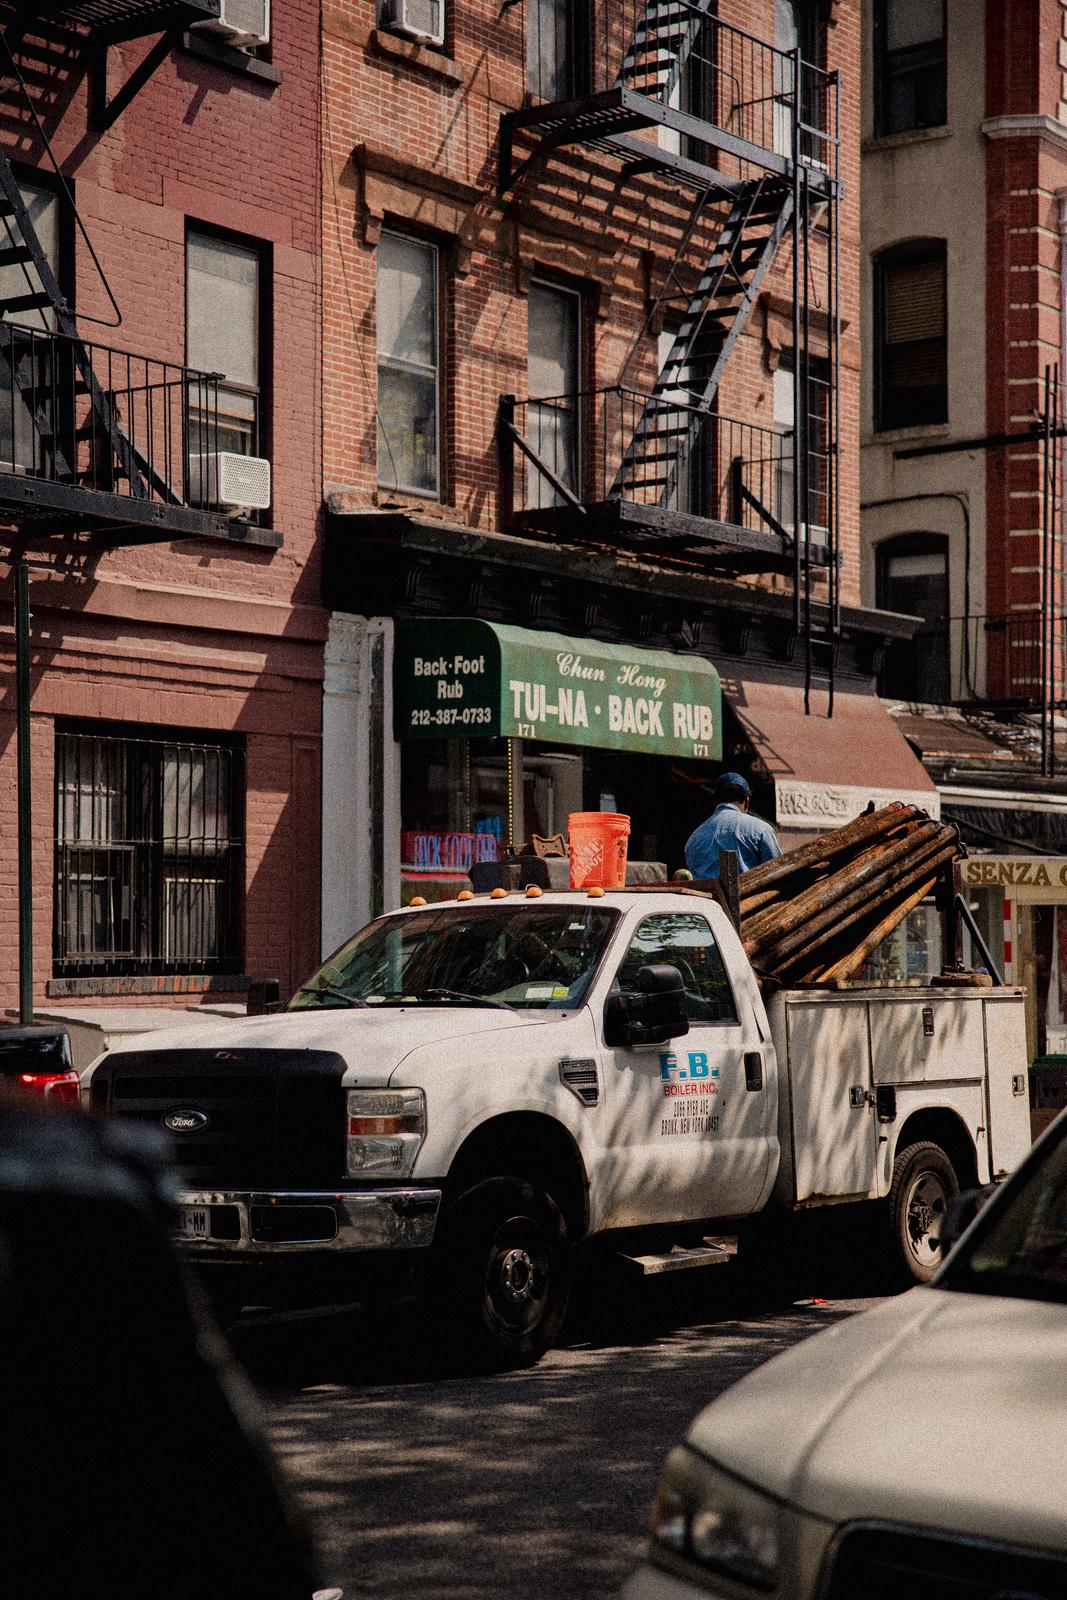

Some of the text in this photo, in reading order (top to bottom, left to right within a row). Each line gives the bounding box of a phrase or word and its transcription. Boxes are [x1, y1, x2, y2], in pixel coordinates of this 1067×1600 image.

[556, 652, 667, 698] Chun Hong
[437, 680, 464, 699] Rub
[411, 707, 492, 726] 212-387-0733
[509, 680, 714, 741] TUI-NA BACK RUB
[517, 722, 537, 738] 171
[693, 743, 709, 757] 171
[966, 861, 1052, 886] SENZA
[658, 1051, 720, 1082] F.B.
[663, 1083, 719, 1097] BOILER INC.
[171, 1115, 195, 1127] Ford
